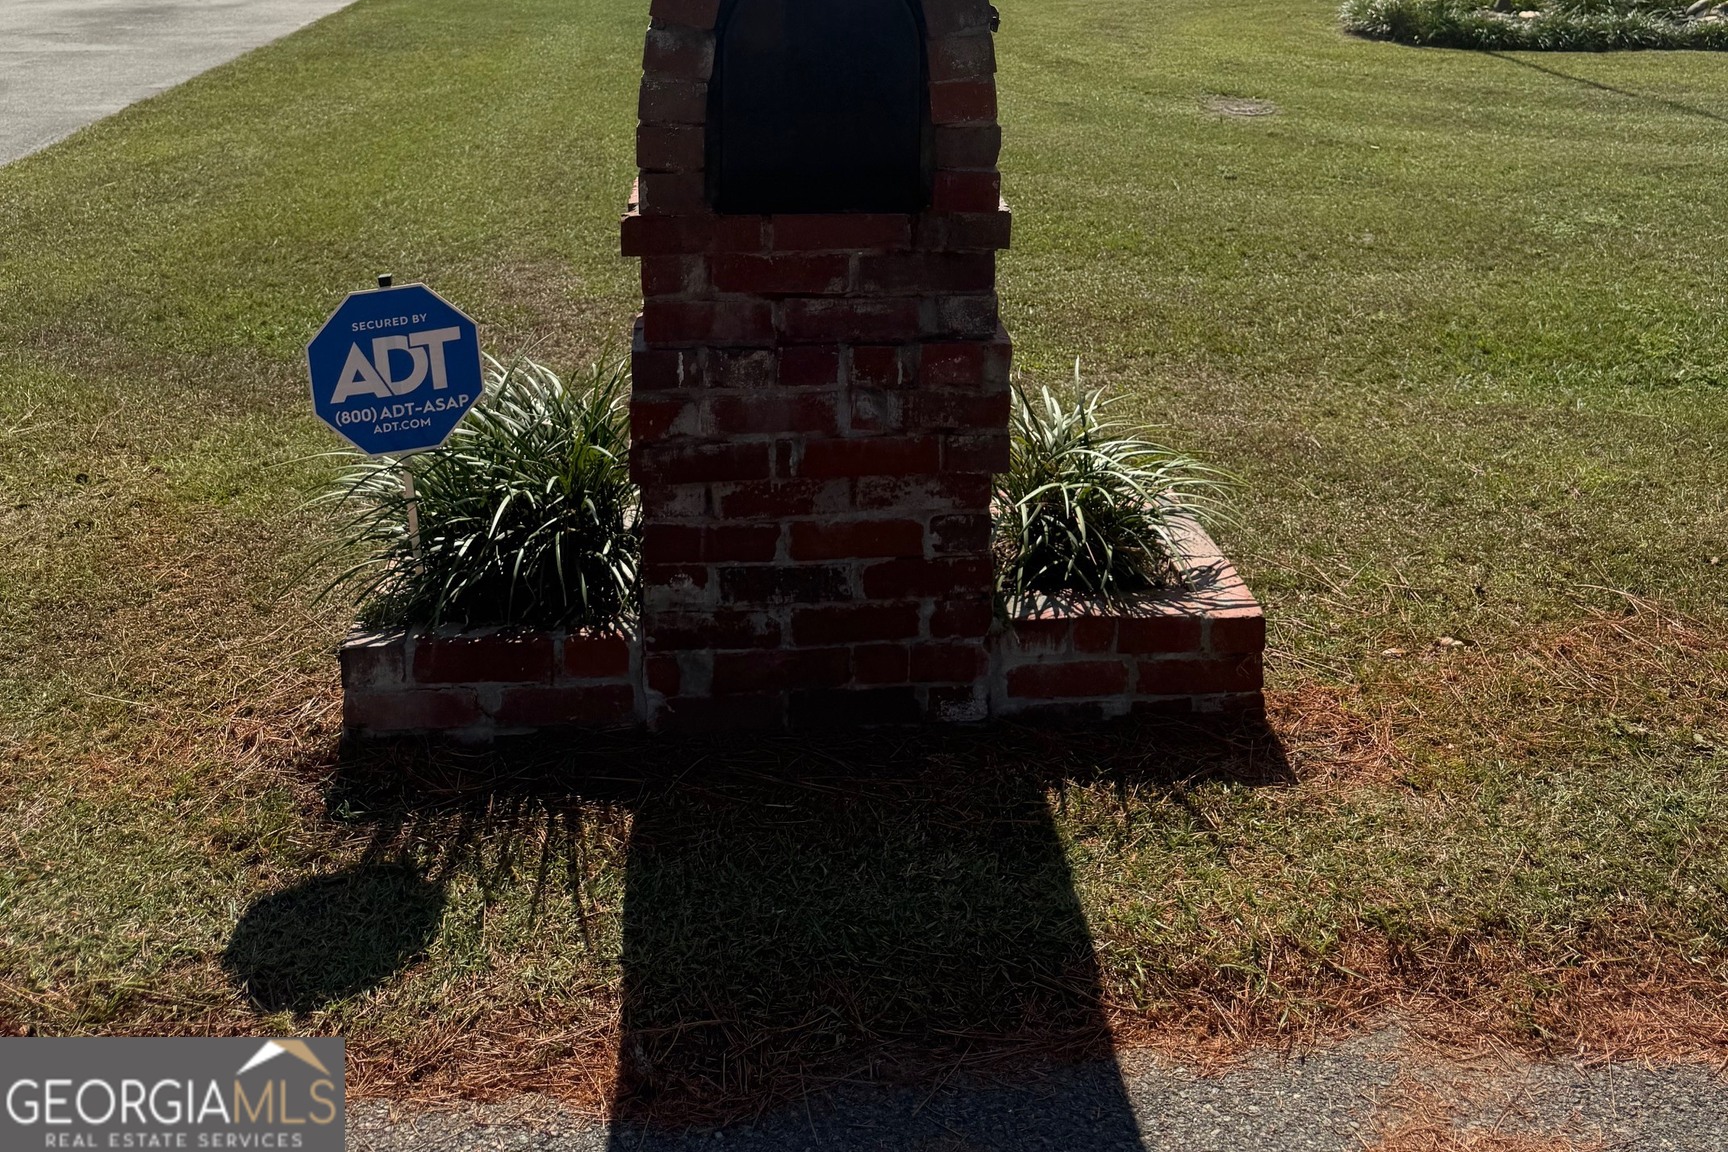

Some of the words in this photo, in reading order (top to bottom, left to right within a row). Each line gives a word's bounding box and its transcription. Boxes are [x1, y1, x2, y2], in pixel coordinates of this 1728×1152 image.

[352, 316, 408, 331] SECURED
[412, 313, 427, 323] BY
[330, 326, 461, 404] ADT
[335, 407, 377, 427] (800)
[380, 394, 469, 420] ADT-ASAP
[374, 418, 431, 434] ADT.COM
